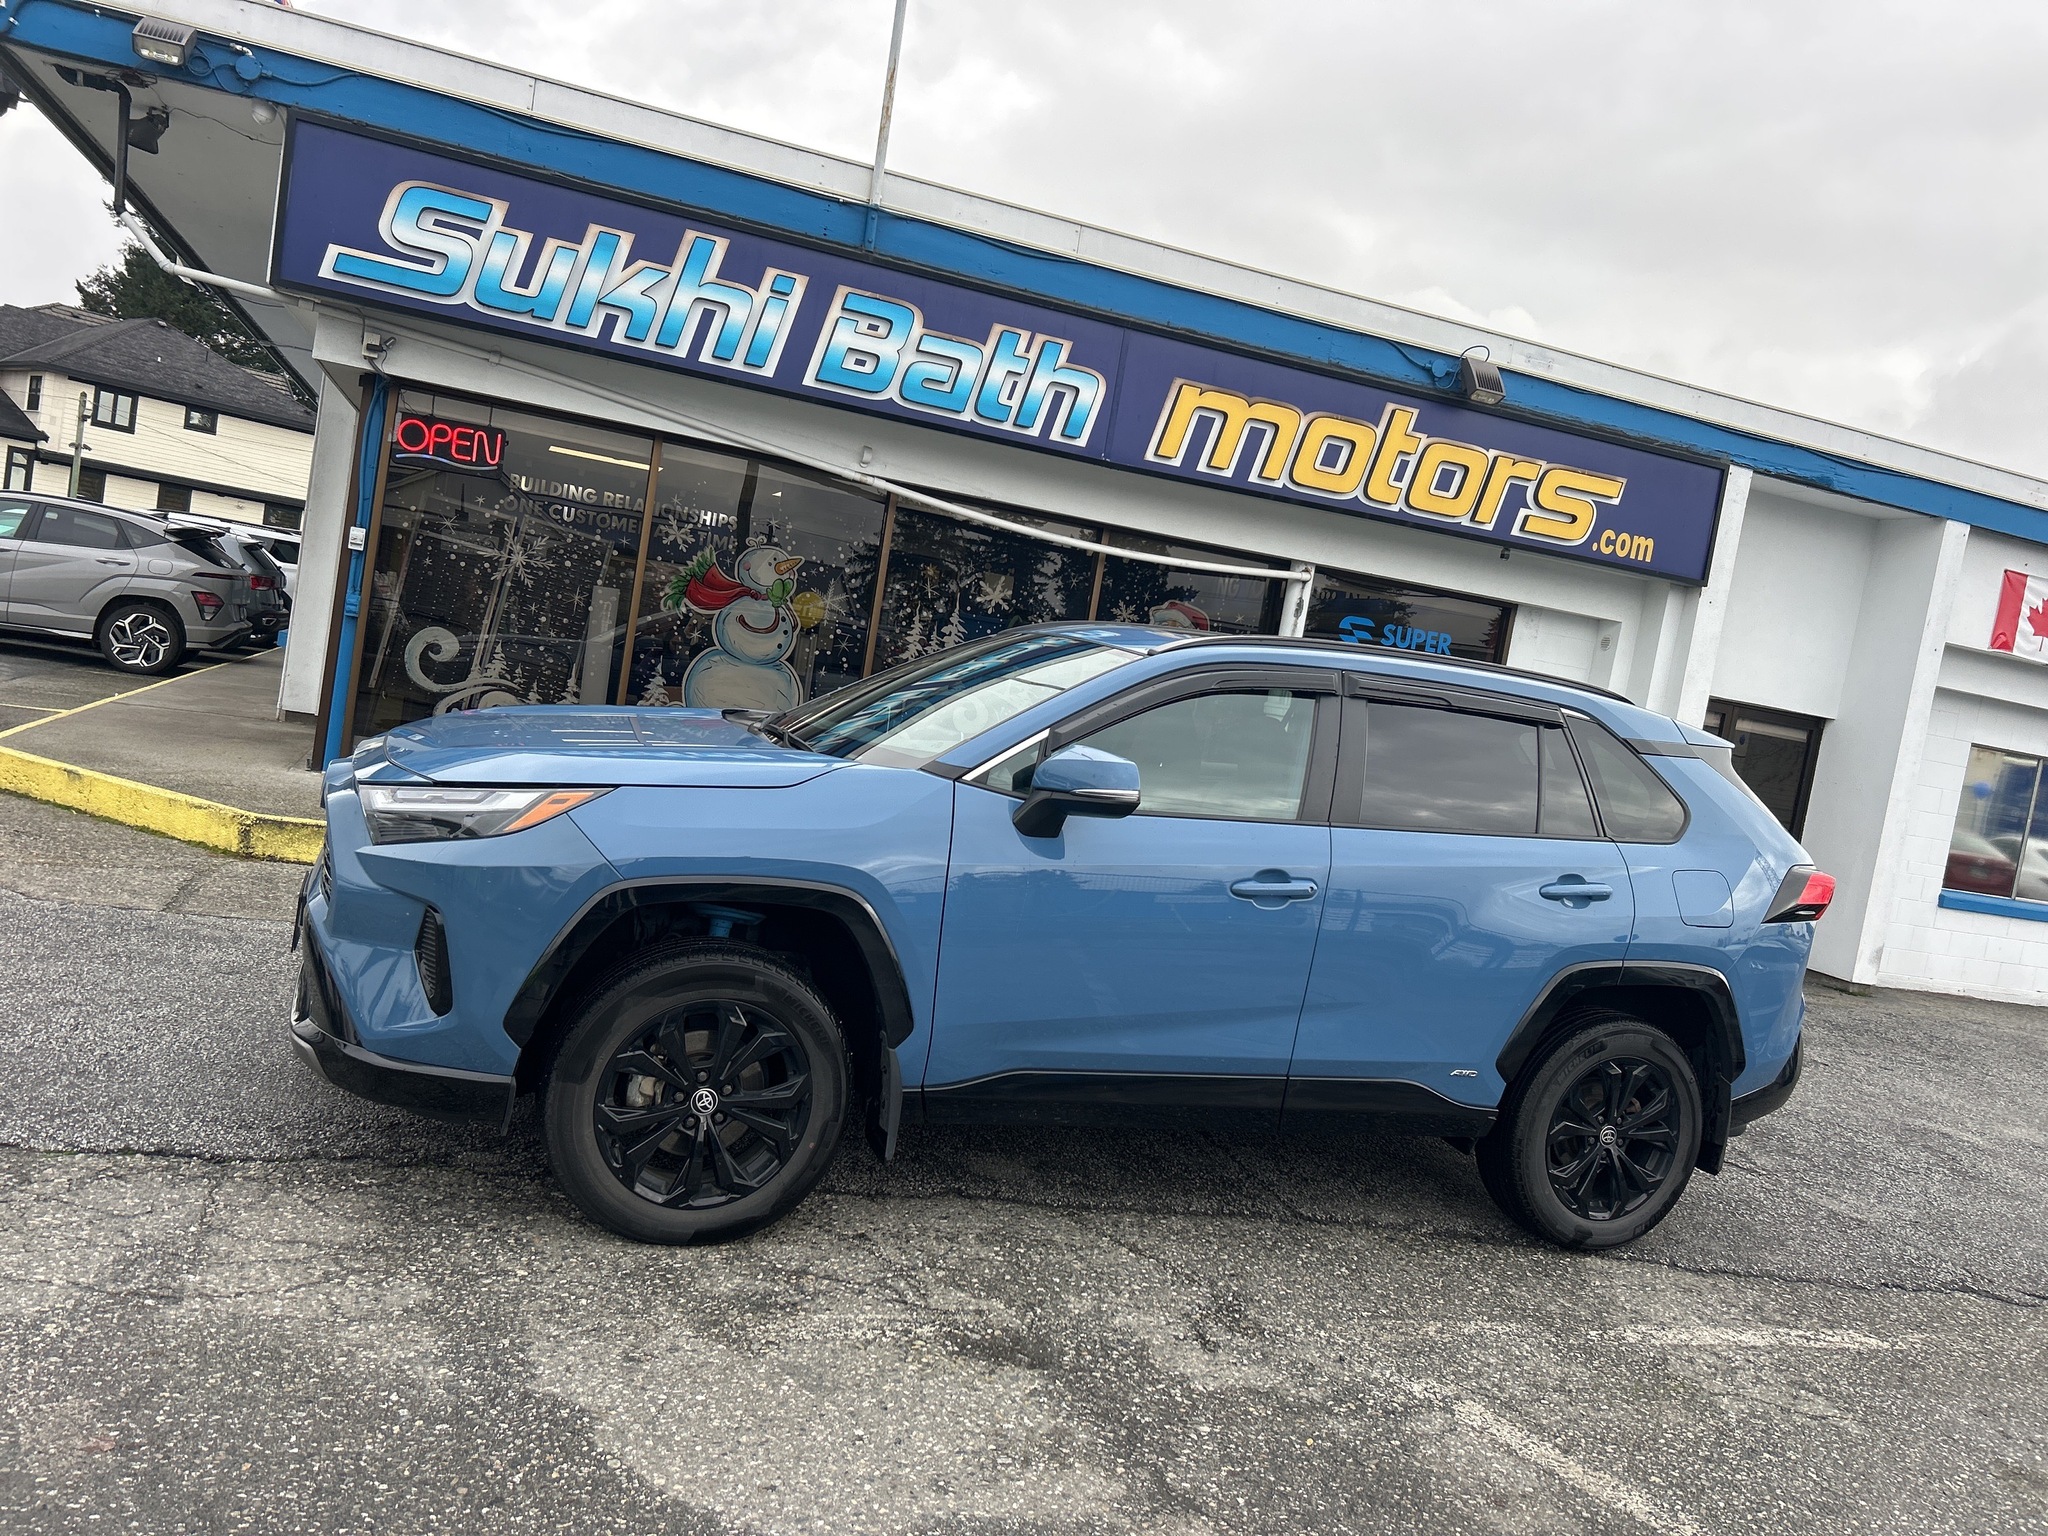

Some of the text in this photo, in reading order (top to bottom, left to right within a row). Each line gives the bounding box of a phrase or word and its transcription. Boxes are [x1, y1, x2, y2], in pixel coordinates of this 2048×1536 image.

[320, 181, 1654, 562] Sukhi Bath motors .com
[397, 419, 501, 465] OPEN
[503, 496, 545, 516] ONE
[508, 473, 739, 531] BUILDING RELAIONSHIPS
[1380, 623, 1453, 655] SUPER
